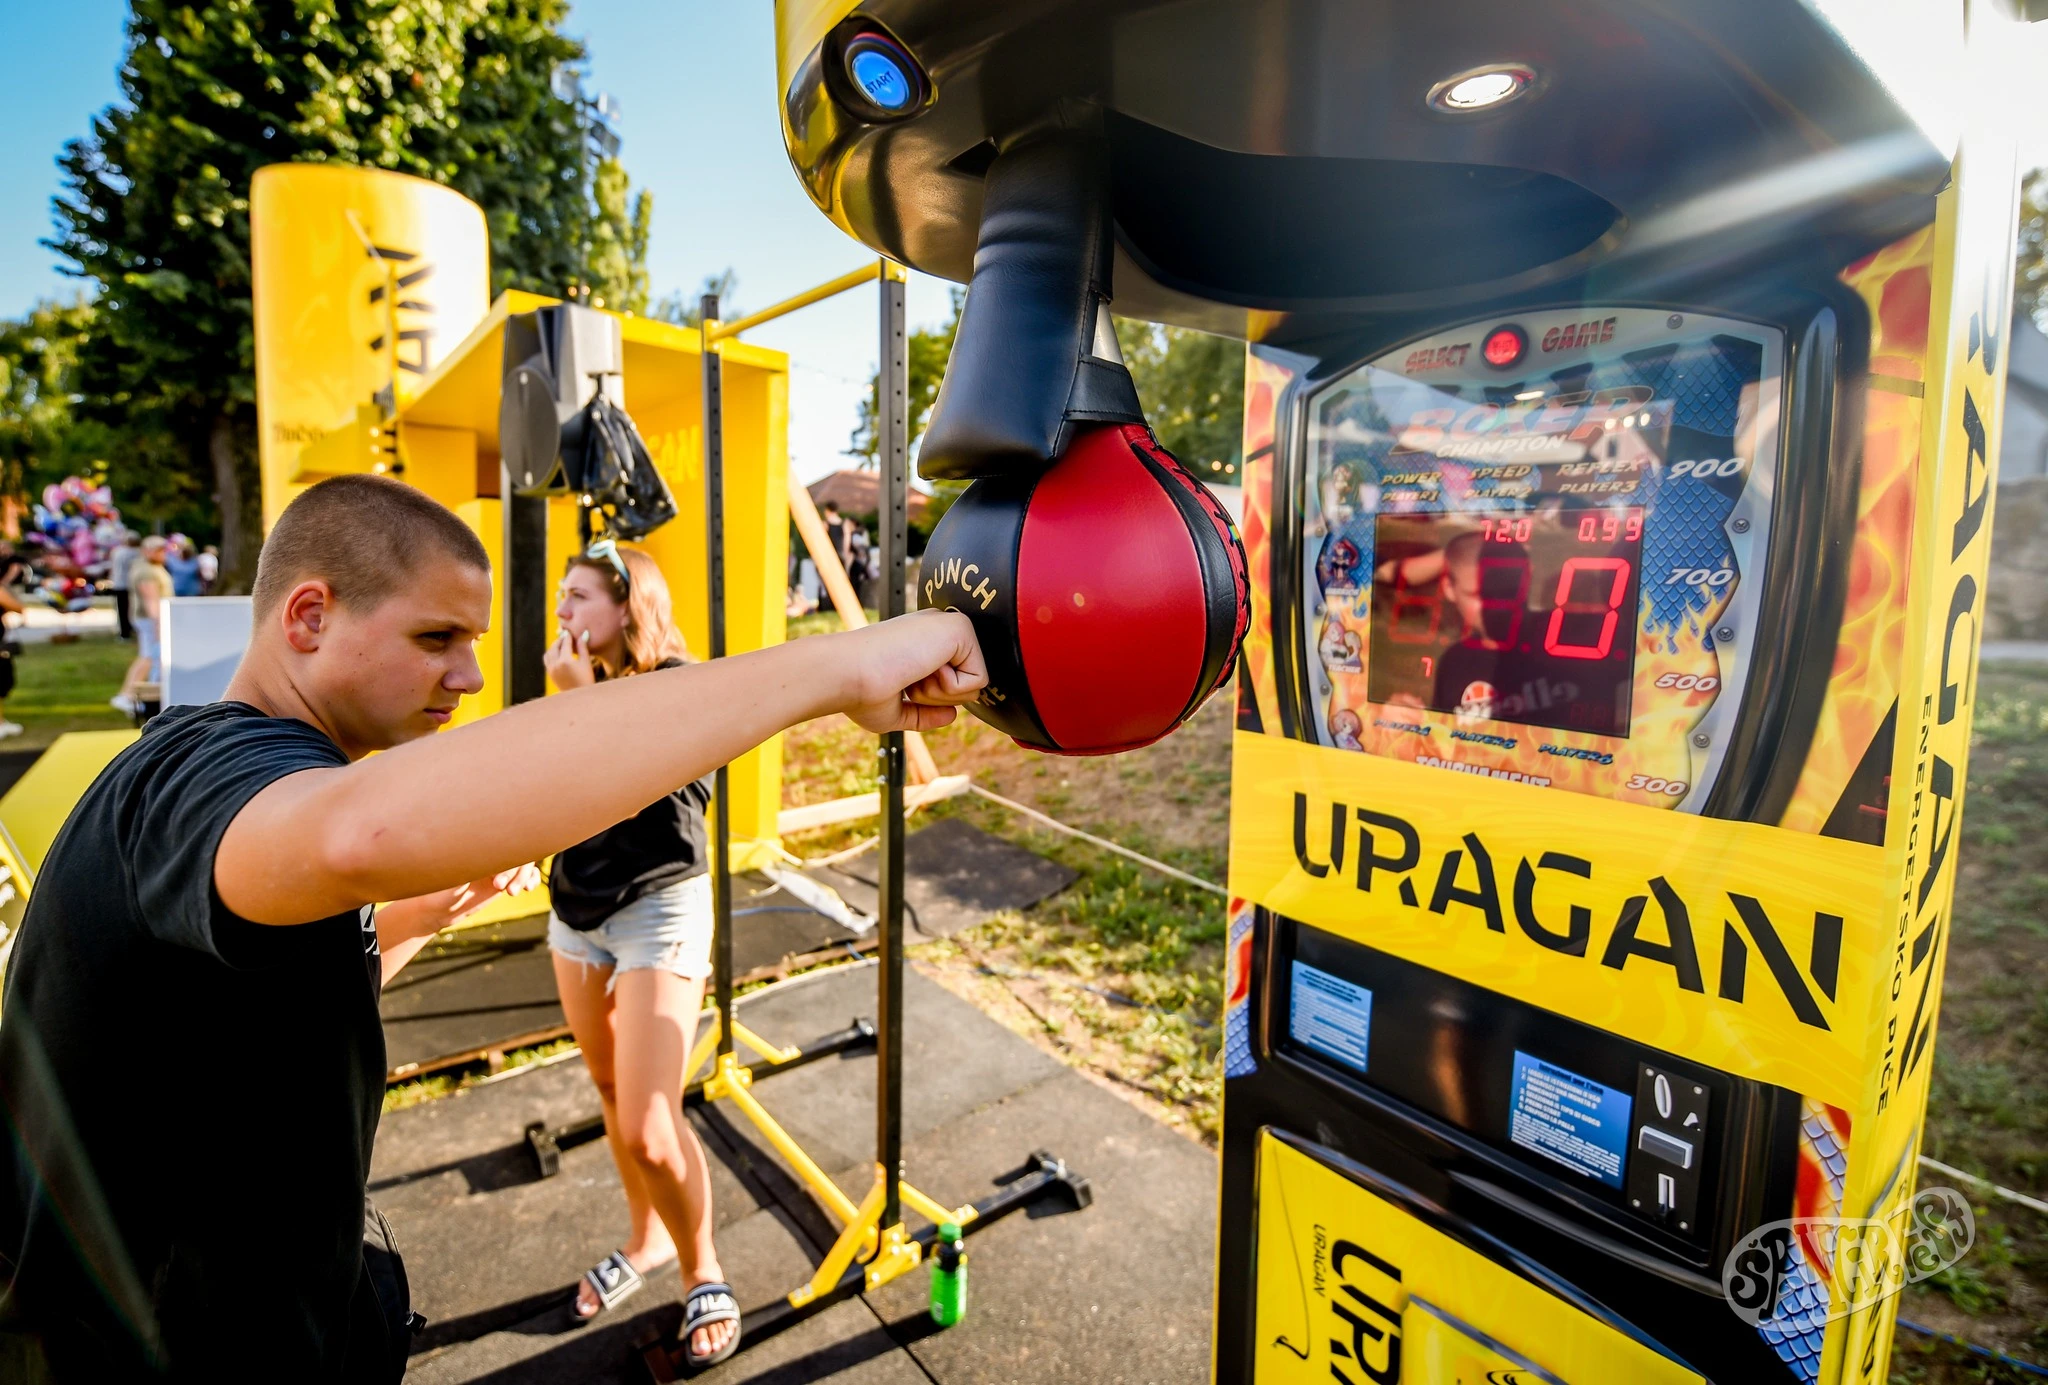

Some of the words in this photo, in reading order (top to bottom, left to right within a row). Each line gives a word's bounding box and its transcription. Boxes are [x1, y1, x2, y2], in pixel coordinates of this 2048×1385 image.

[865, 71, 894, 93] START
[1405, 343, 1471, 373] SELECT
[1541, 317, 1617, 352] GAME
[1390, 386, 1654, 455] BOXER
[1436, 433, 1569, 458] CHAMPION
[1381, 471, 1442, 486] POWER
[1470, 464, 1532, 480] SPEED
[1556, 458, 1647, 477] REFLEX
[1667, 457, 1746, 480] 900
[1559, 480, 1639, 494] PLAYER3
[1577, 517, 1643, 542] 0.99
[925, 558, 997, 610] PUNCH
[1665, 568, 1734, 586] 700
[1543, 557, 1631, 660] 0
[1655, 673, 1718, 692] 500
[1538, 744, 1614, 765] PLAYER6
[1626, 774, 1687, 796] 300
[1891, 694, 1933, 1004] ENERGETSKO
[1293, 791, 1844, 1032] URAGAN
[1313, 1223, 1327, 1298] URAGAN
